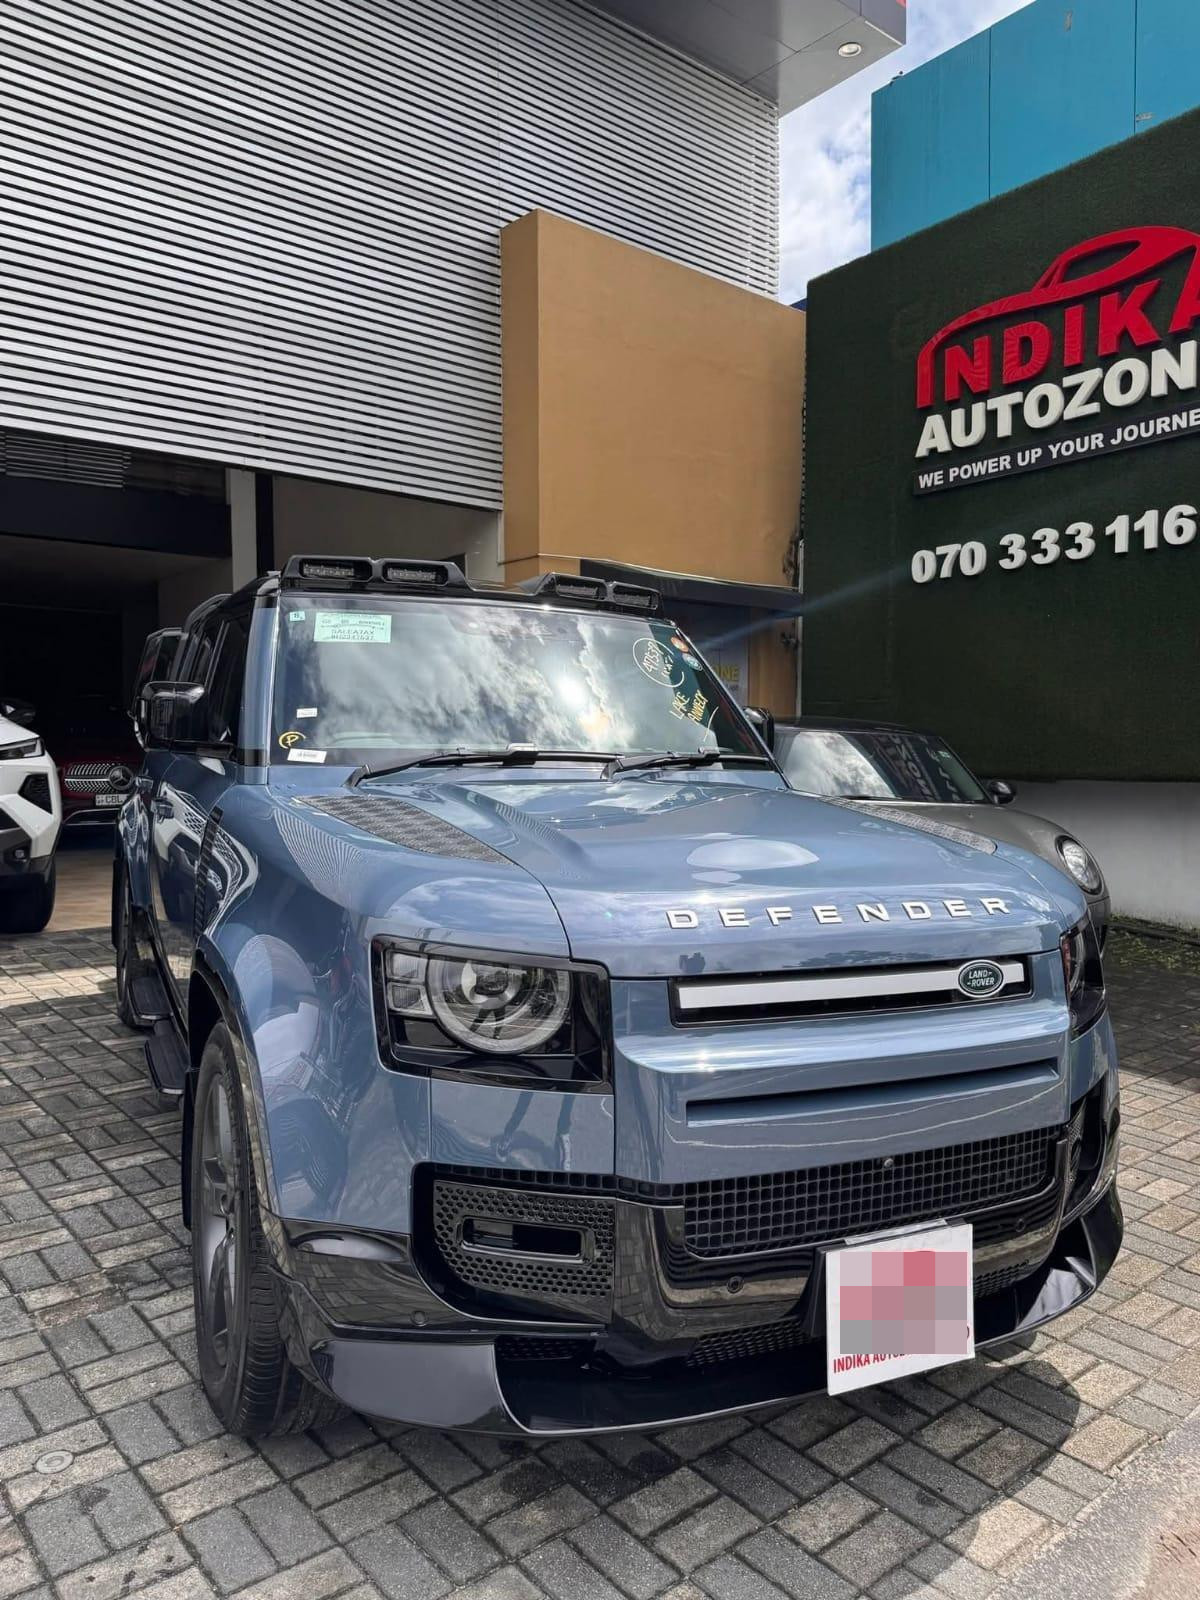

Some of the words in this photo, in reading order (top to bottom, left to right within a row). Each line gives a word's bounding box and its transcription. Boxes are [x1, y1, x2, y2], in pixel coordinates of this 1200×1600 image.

[914, 340, 1197, 459] AUTOZON
[918, 463, 944, 489] WE
[949, 455, 1011, 482] POWER
[1016, 447, 1043, 467] UP
[1048, 432, 1104, 460] YOUR
[911, 541, 987, 583] 070
[999, 521, 1096, 570] 333
[1105, 504, 1198, 554] 116
[665, 897, 1010, 930] DEFENDER
